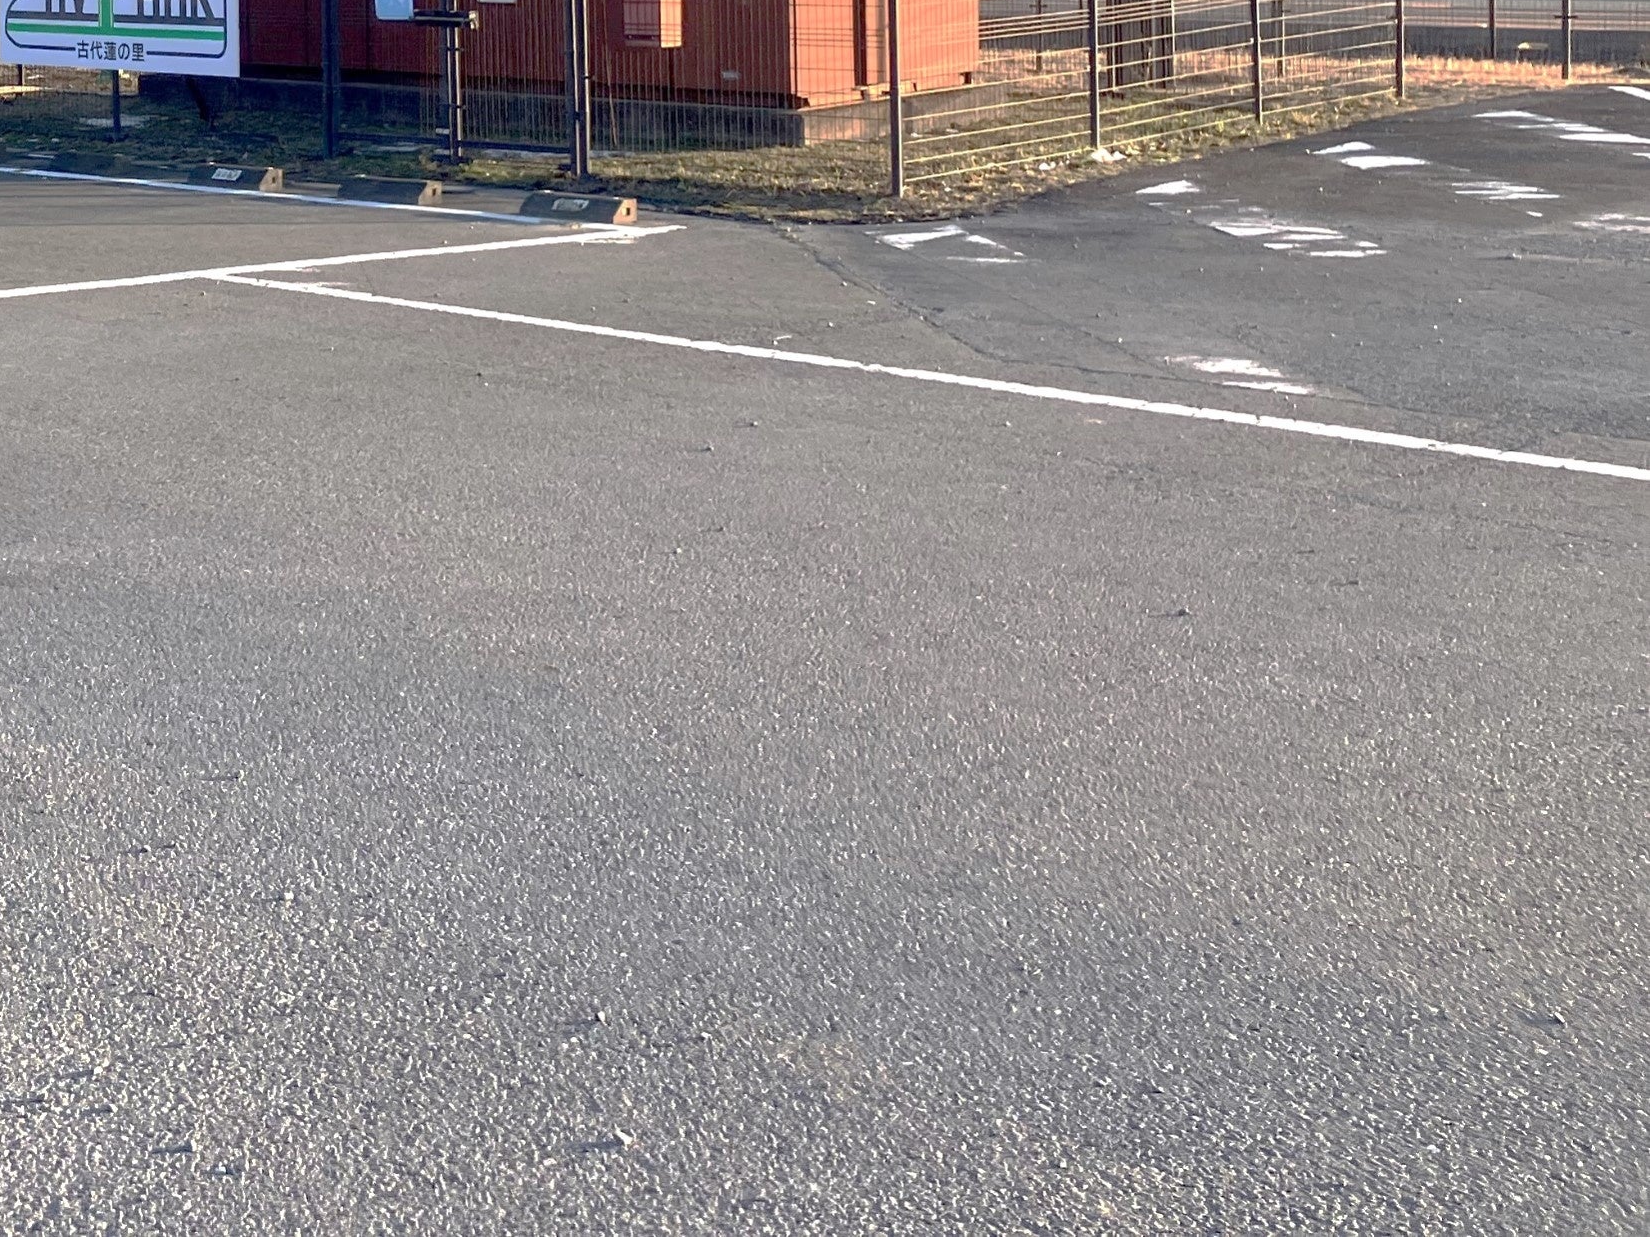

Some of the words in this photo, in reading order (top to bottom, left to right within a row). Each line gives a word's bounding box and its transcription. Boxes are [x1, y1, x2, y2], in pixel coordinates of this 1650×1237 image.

[76, 40, 146, 62] 古代蓮の里
